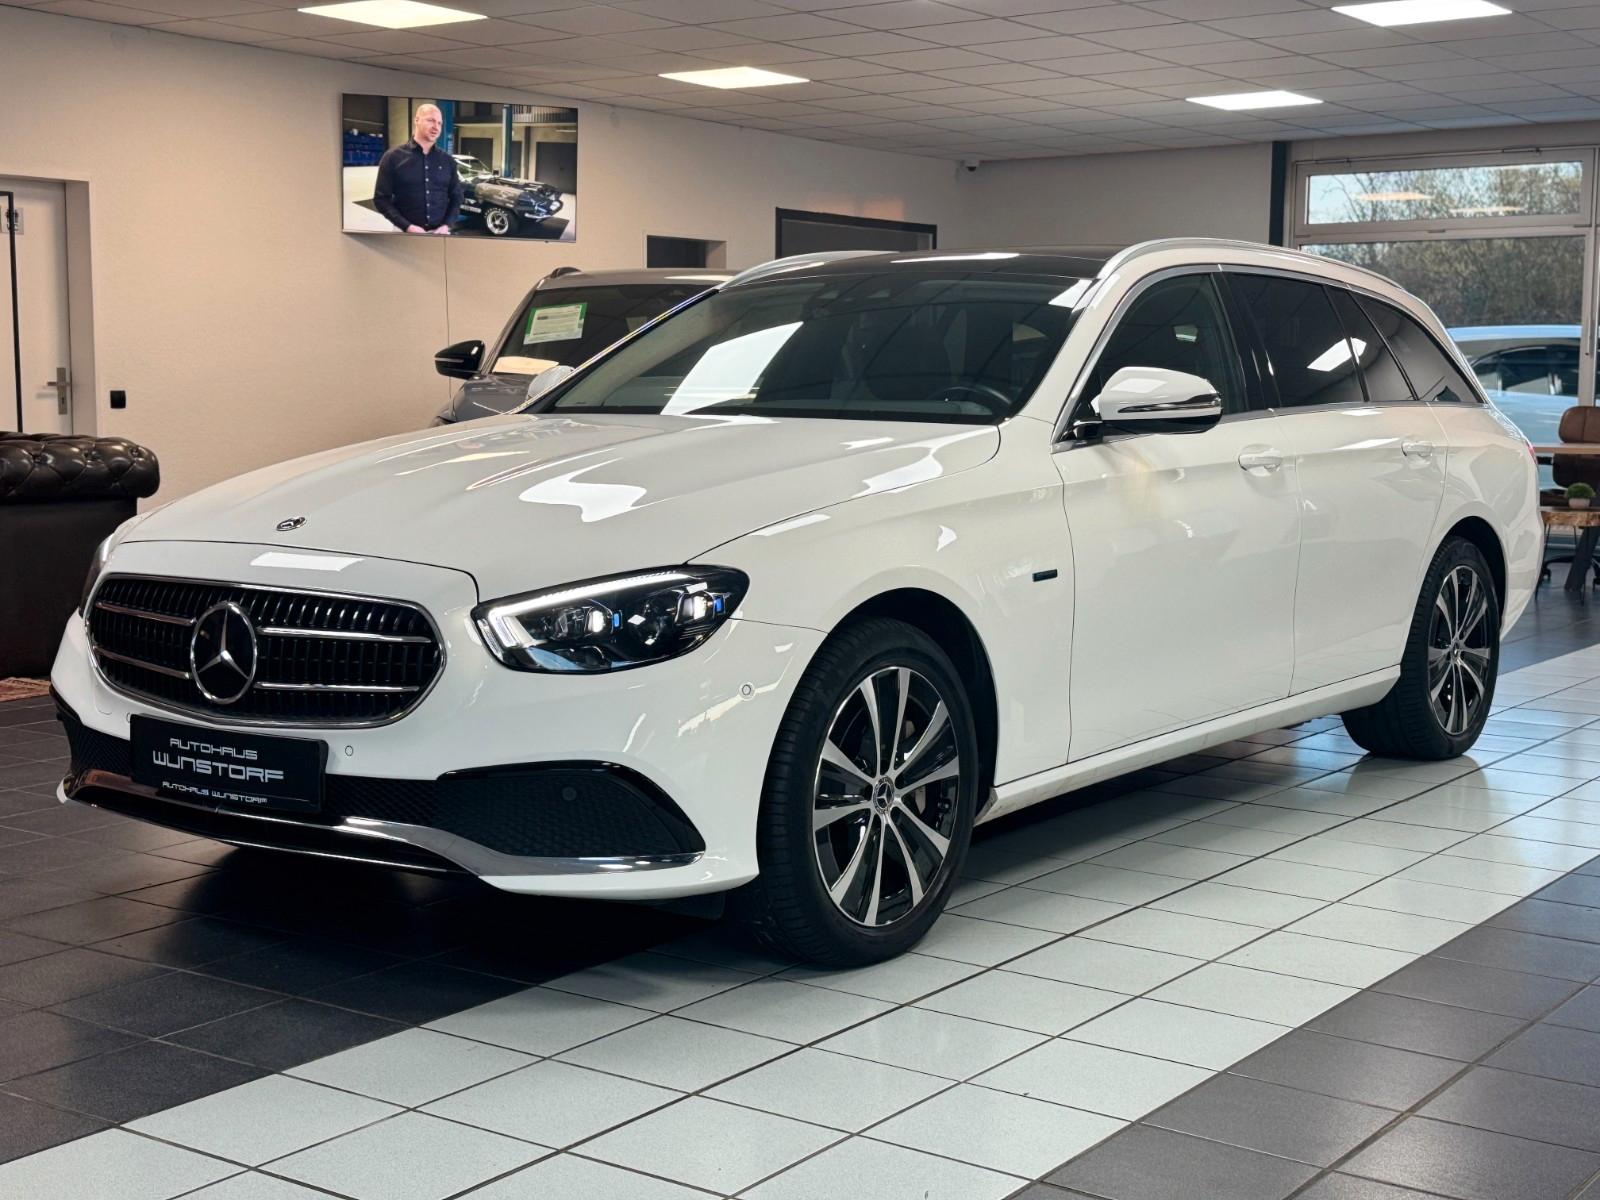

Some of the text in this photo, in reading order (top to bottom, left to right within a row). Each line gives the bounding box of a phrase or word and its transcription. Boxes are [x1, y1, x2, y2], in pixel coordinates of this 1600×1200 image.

[169, 737, 258, 760] AUTOHAUS
[152, 750, 284, 782] WUNSTORF
[162, 781, 267, 803] AUTOHAUS WUNSTORF
